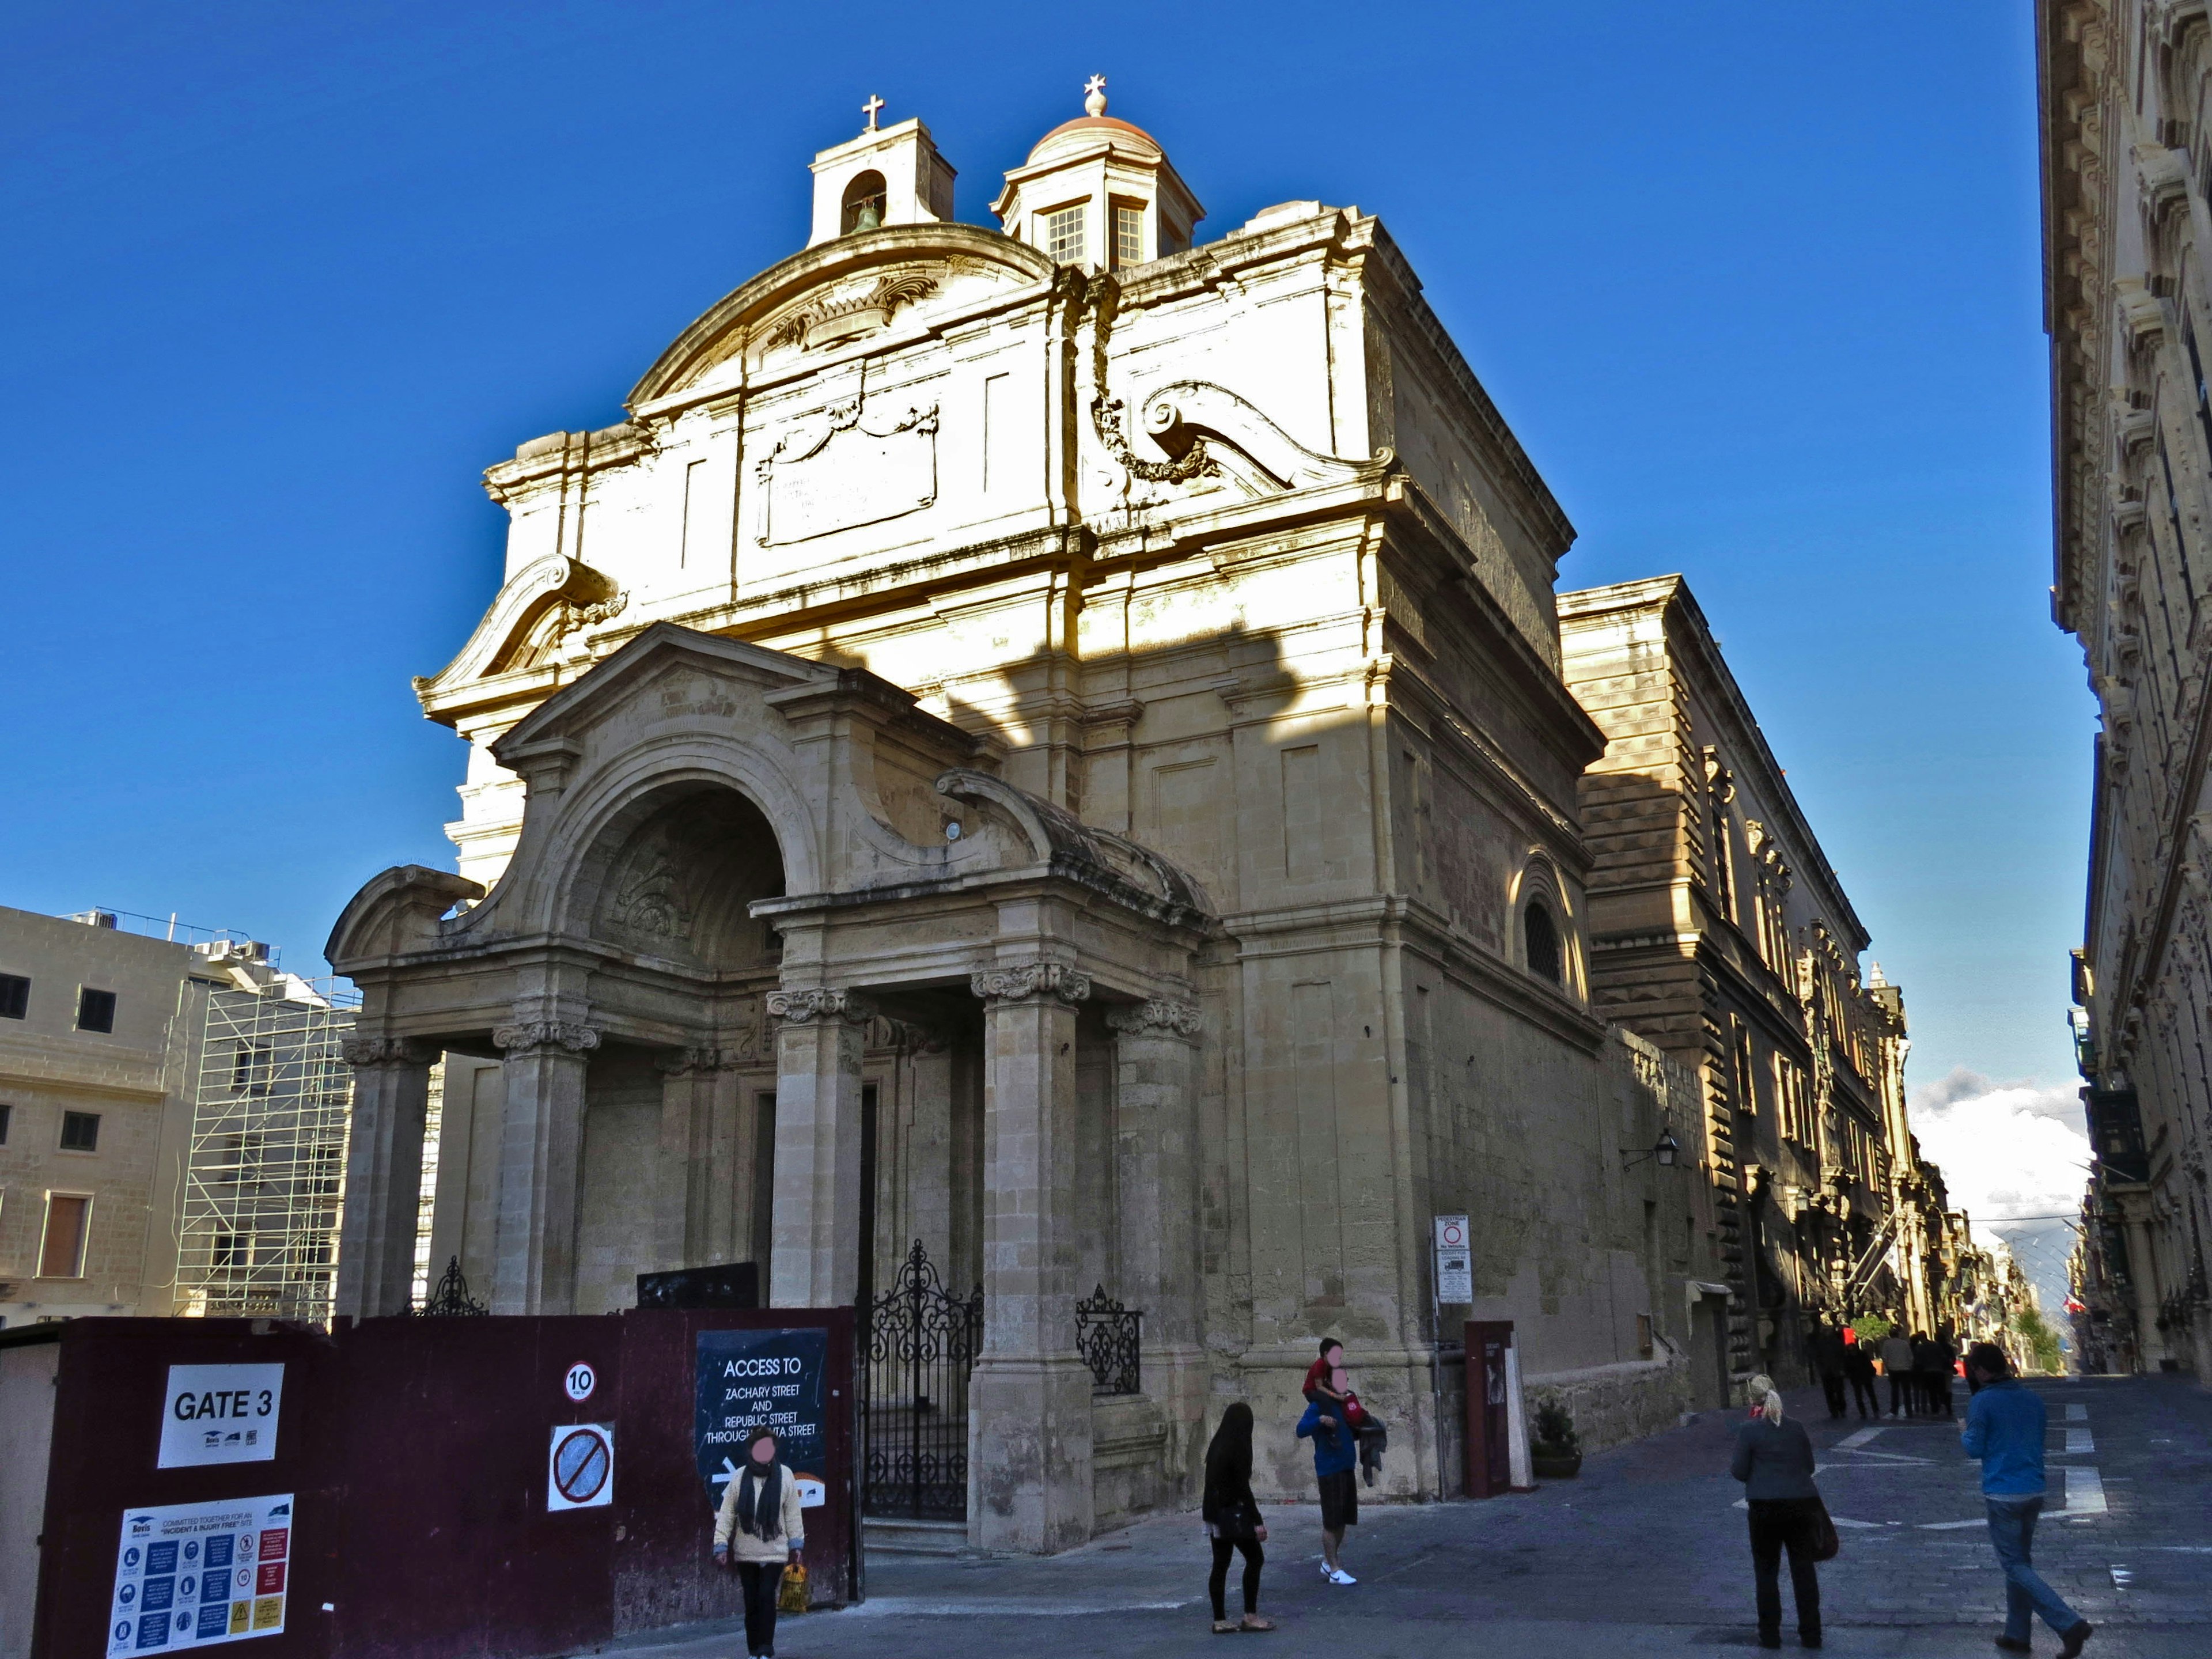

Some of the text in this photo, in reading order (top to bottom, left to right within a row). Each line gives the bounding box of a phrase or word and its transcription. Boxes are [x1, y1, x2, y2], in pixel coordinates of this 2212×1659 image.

[724, 1357, 801, 1377] ACCESS TO
[570, 1370, 592, 1391] 10
[726, 1384, 800, 1400] ZACHARY STREET
[175, 1389, 272, 1421] GATE 3
[751, 1400, 772, 1412] AND
[725, 1411, 798, 1429] REPUBLIC STREET
[788, 1423, 816, 1437] STREET
[132, 1524, 151, 1533] Bovis
[162, 1518, 199, 1528] COMMITTED
[199, 1514, 230, 1524] TOGETHER
[199, 1523, 220, 1531] INJURY
